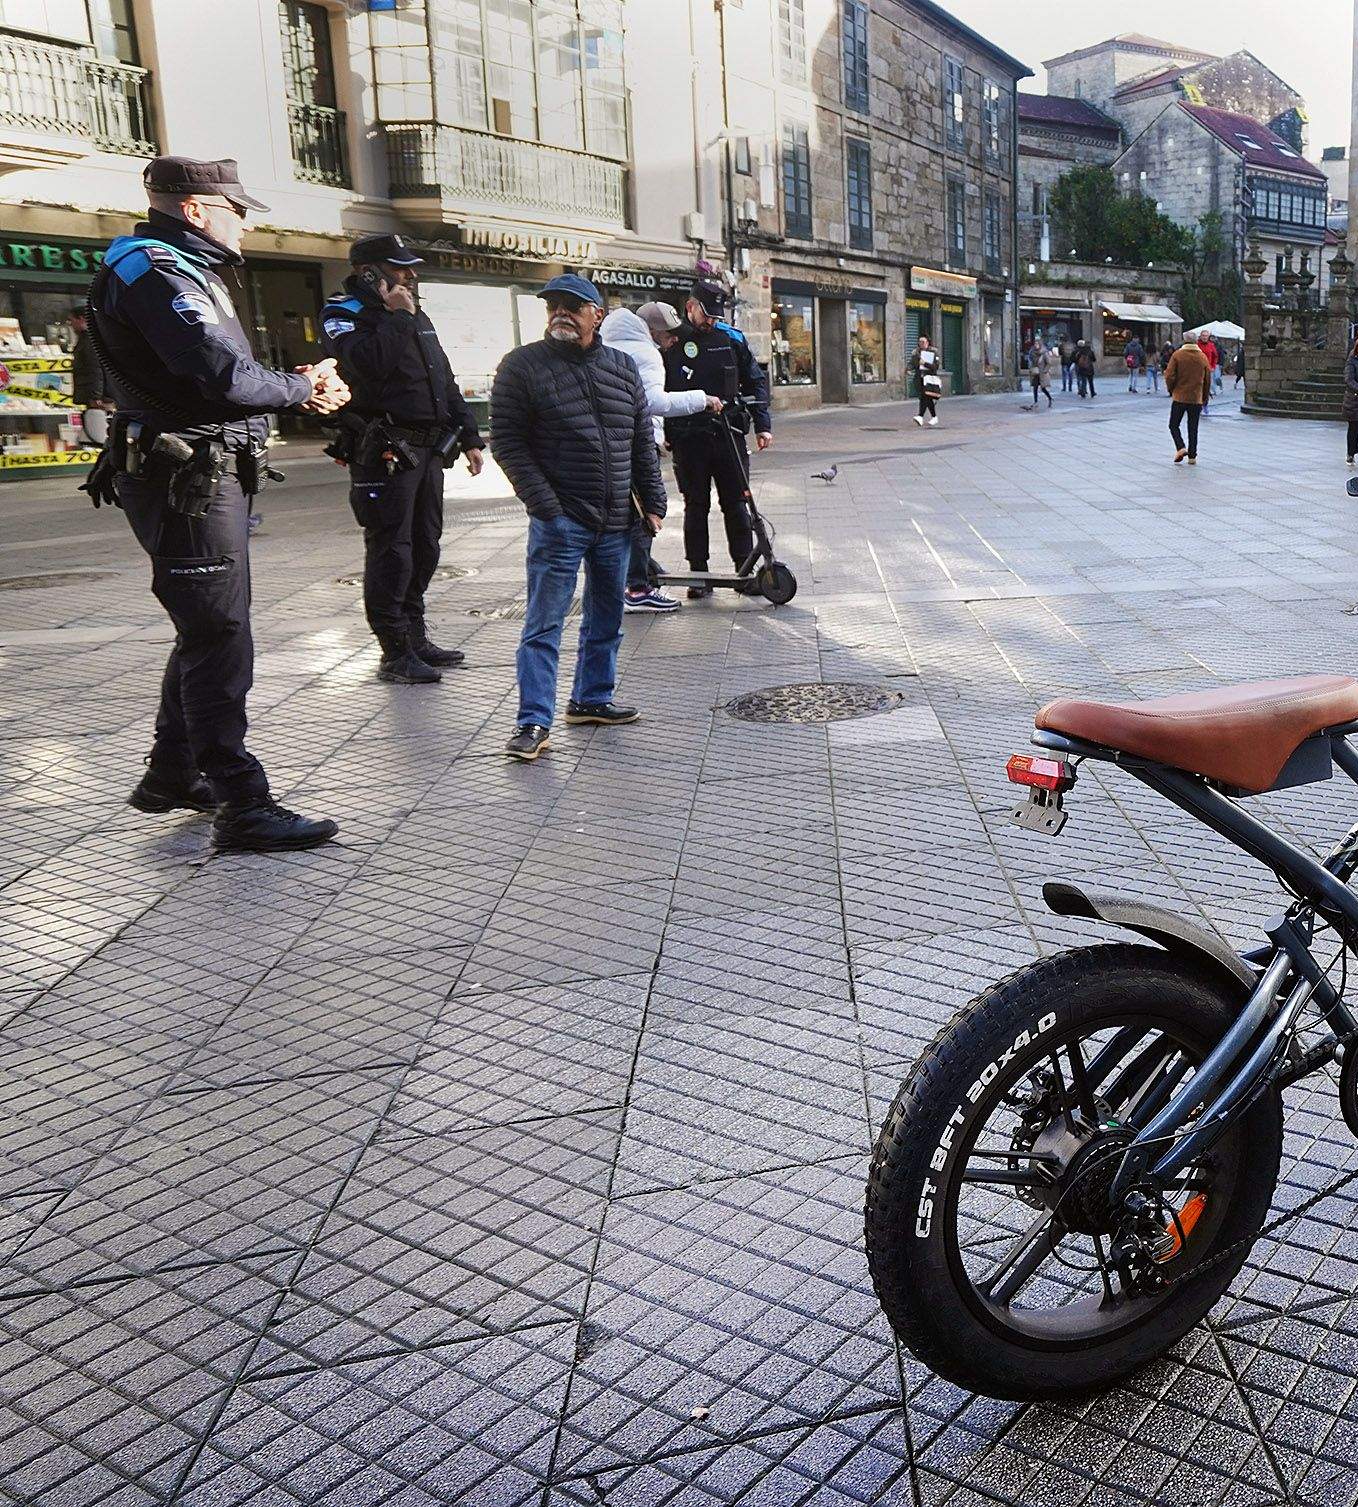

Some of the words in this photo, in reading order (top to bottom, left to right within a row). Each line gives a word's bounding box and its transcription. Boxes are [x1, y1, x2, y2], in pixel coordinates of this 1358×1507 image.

[463, 227, 599, 260] INMOBILIARIA
[439, 253, 522, 275] PEDROSA
[591, 270, 656, 288] AGASALLO
[915, 1177, 937, 1239] CST
[929, 1105, 966, 1172] BFT
[965, 1011, 1057, 1104] 20x4.0
